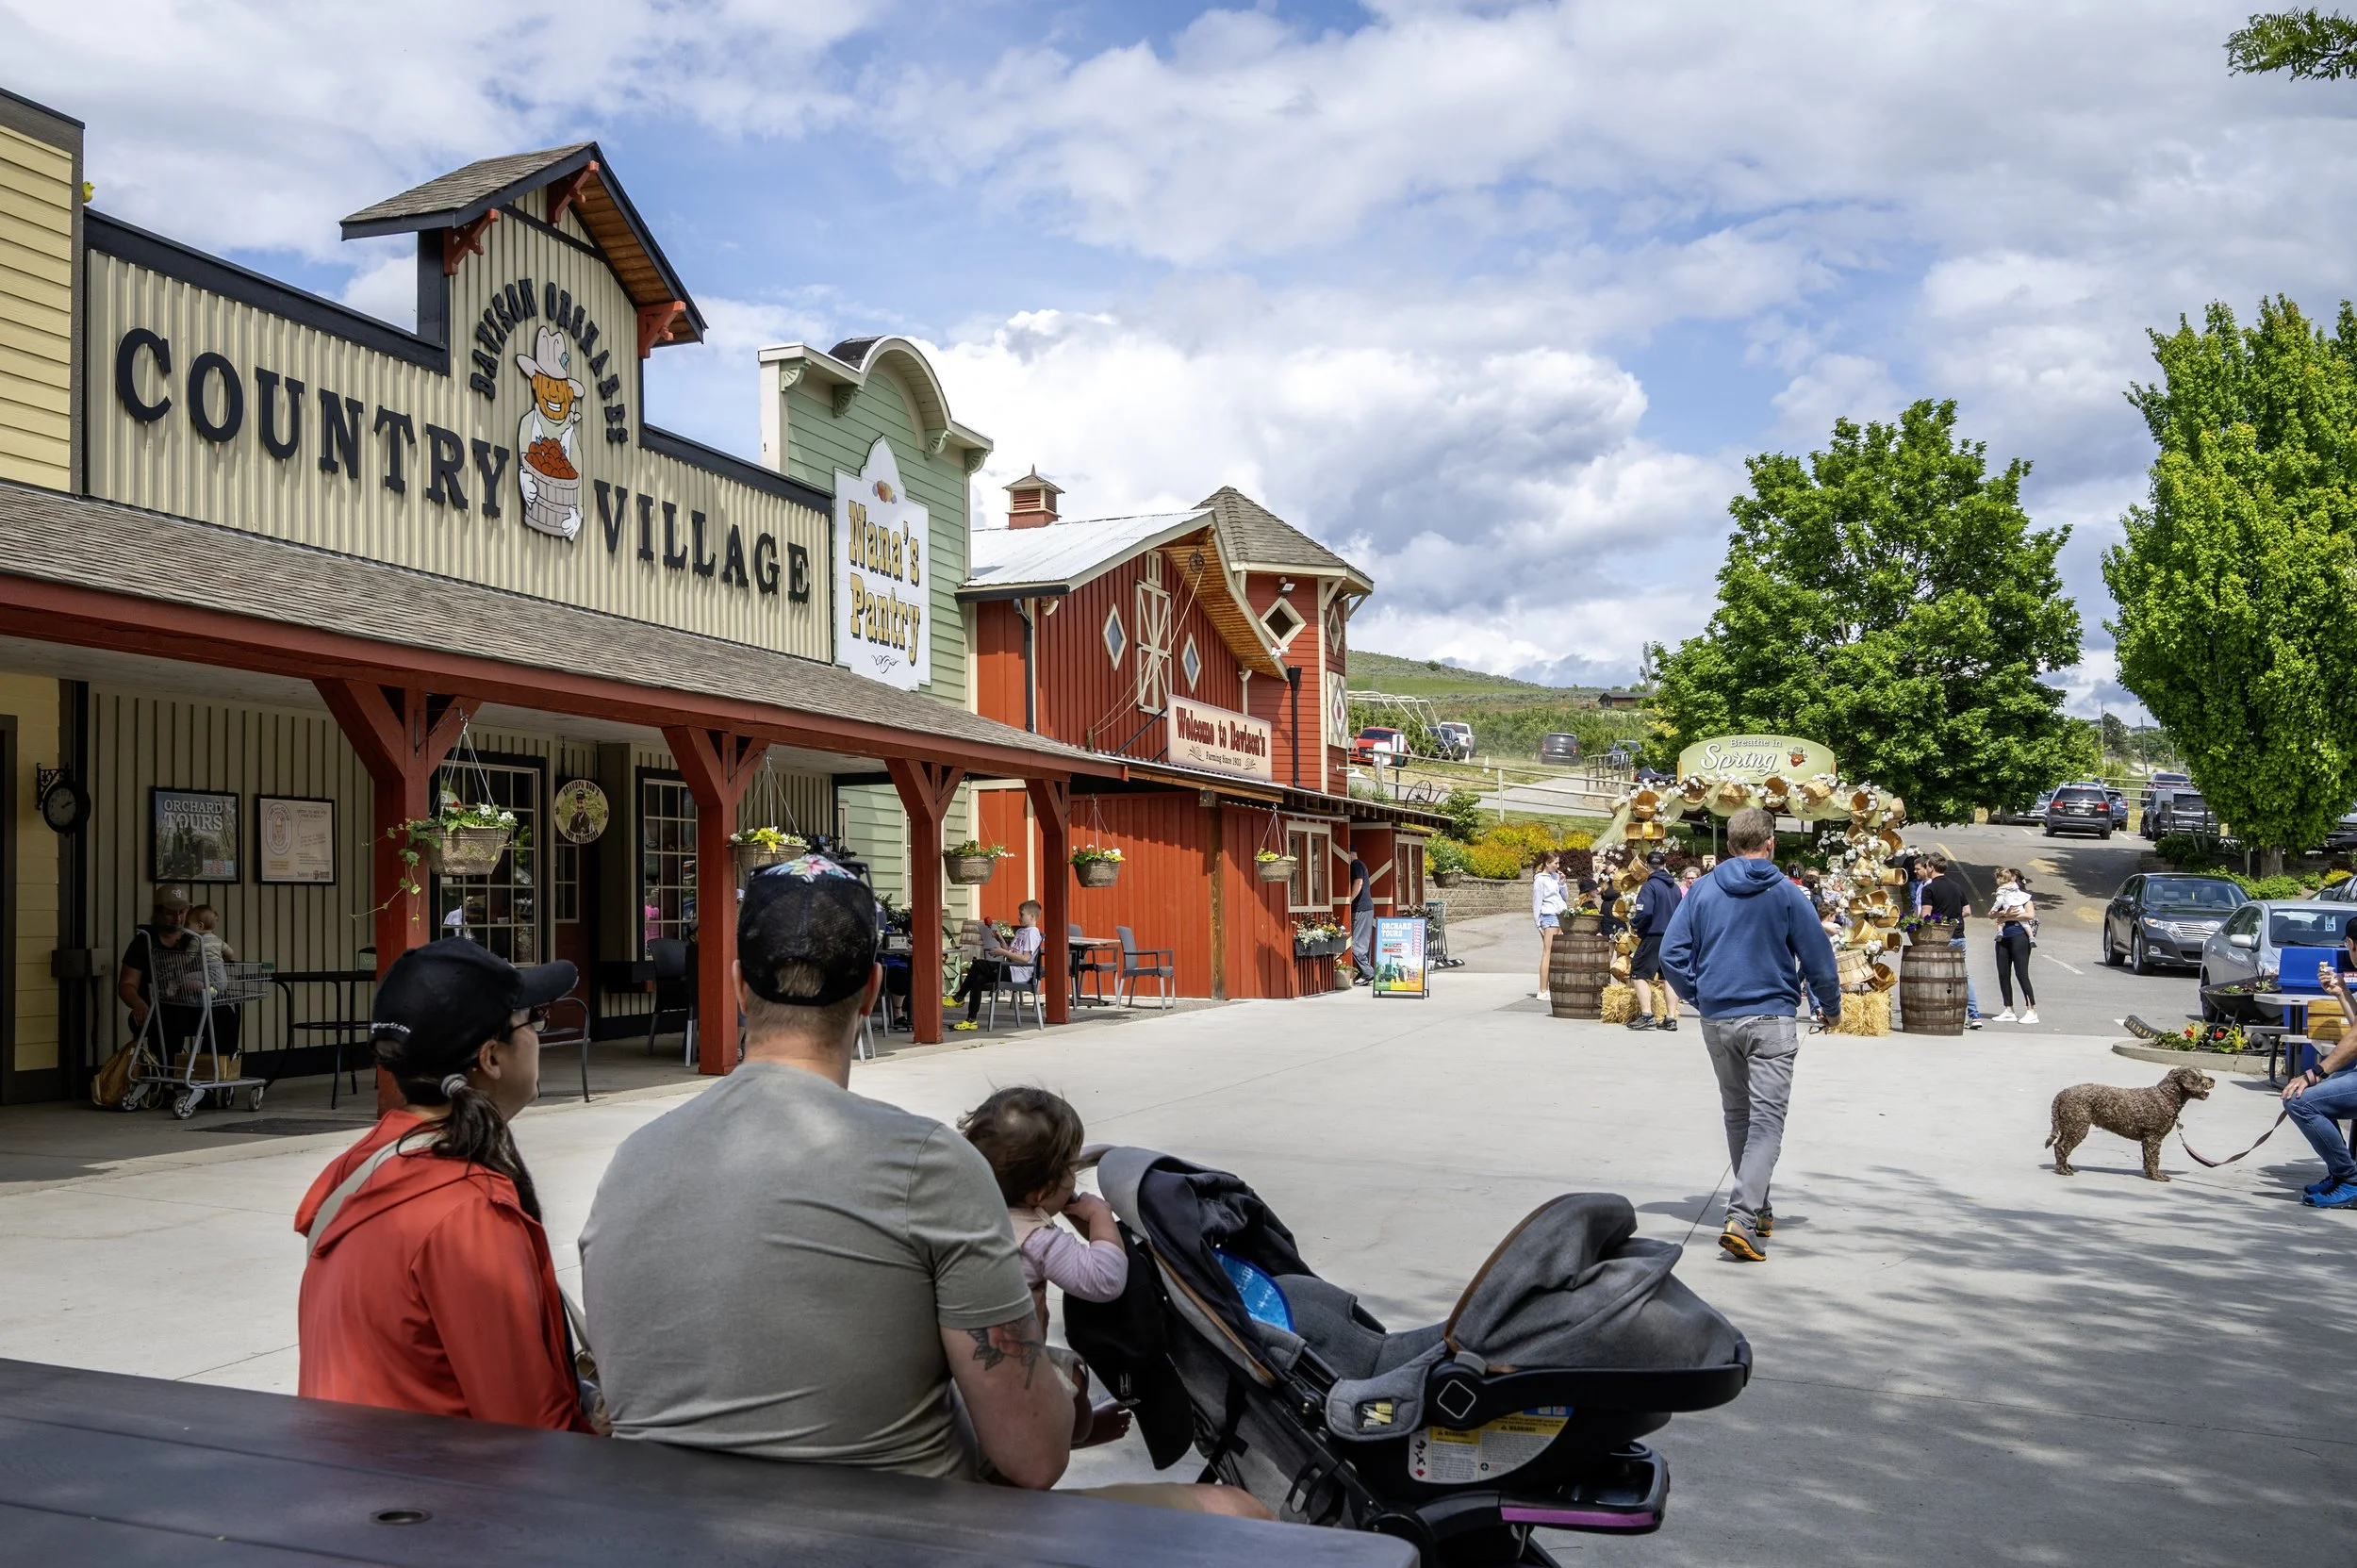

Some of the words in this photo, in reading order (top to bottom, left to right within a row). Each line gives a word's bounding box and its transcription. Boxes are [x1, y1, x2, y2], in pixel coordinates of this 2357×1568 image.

[470, 278, 538, 400] DAVISON
[545, 282, 629, 443] ORCHARDS
[115, 326, 510, 519] COUNTRY
[594, 478, 811, 604] VILLAGE
[849, 499, 919, 587] Nana's
[850, 571, 920, 667] Pantry
[1176, 705, 1214, 746] Welcome
[1218, 719, 1227, 749] to
[1229, 720, 1266, 758] Davison's
[1729, 738, 1769, 748] Breathe
[1772, 738, 1783, 748] in
[1206, 751, 1221, 765] Farming
[1222, 754, 1232, 766] Since
[1700, 743, 1780, 776] Spring
[163, 799, 223, 815] ORCHARD
[164, 812, 223, 832] TOURS
[1381, 922, 1412, 931] ORCHARD
